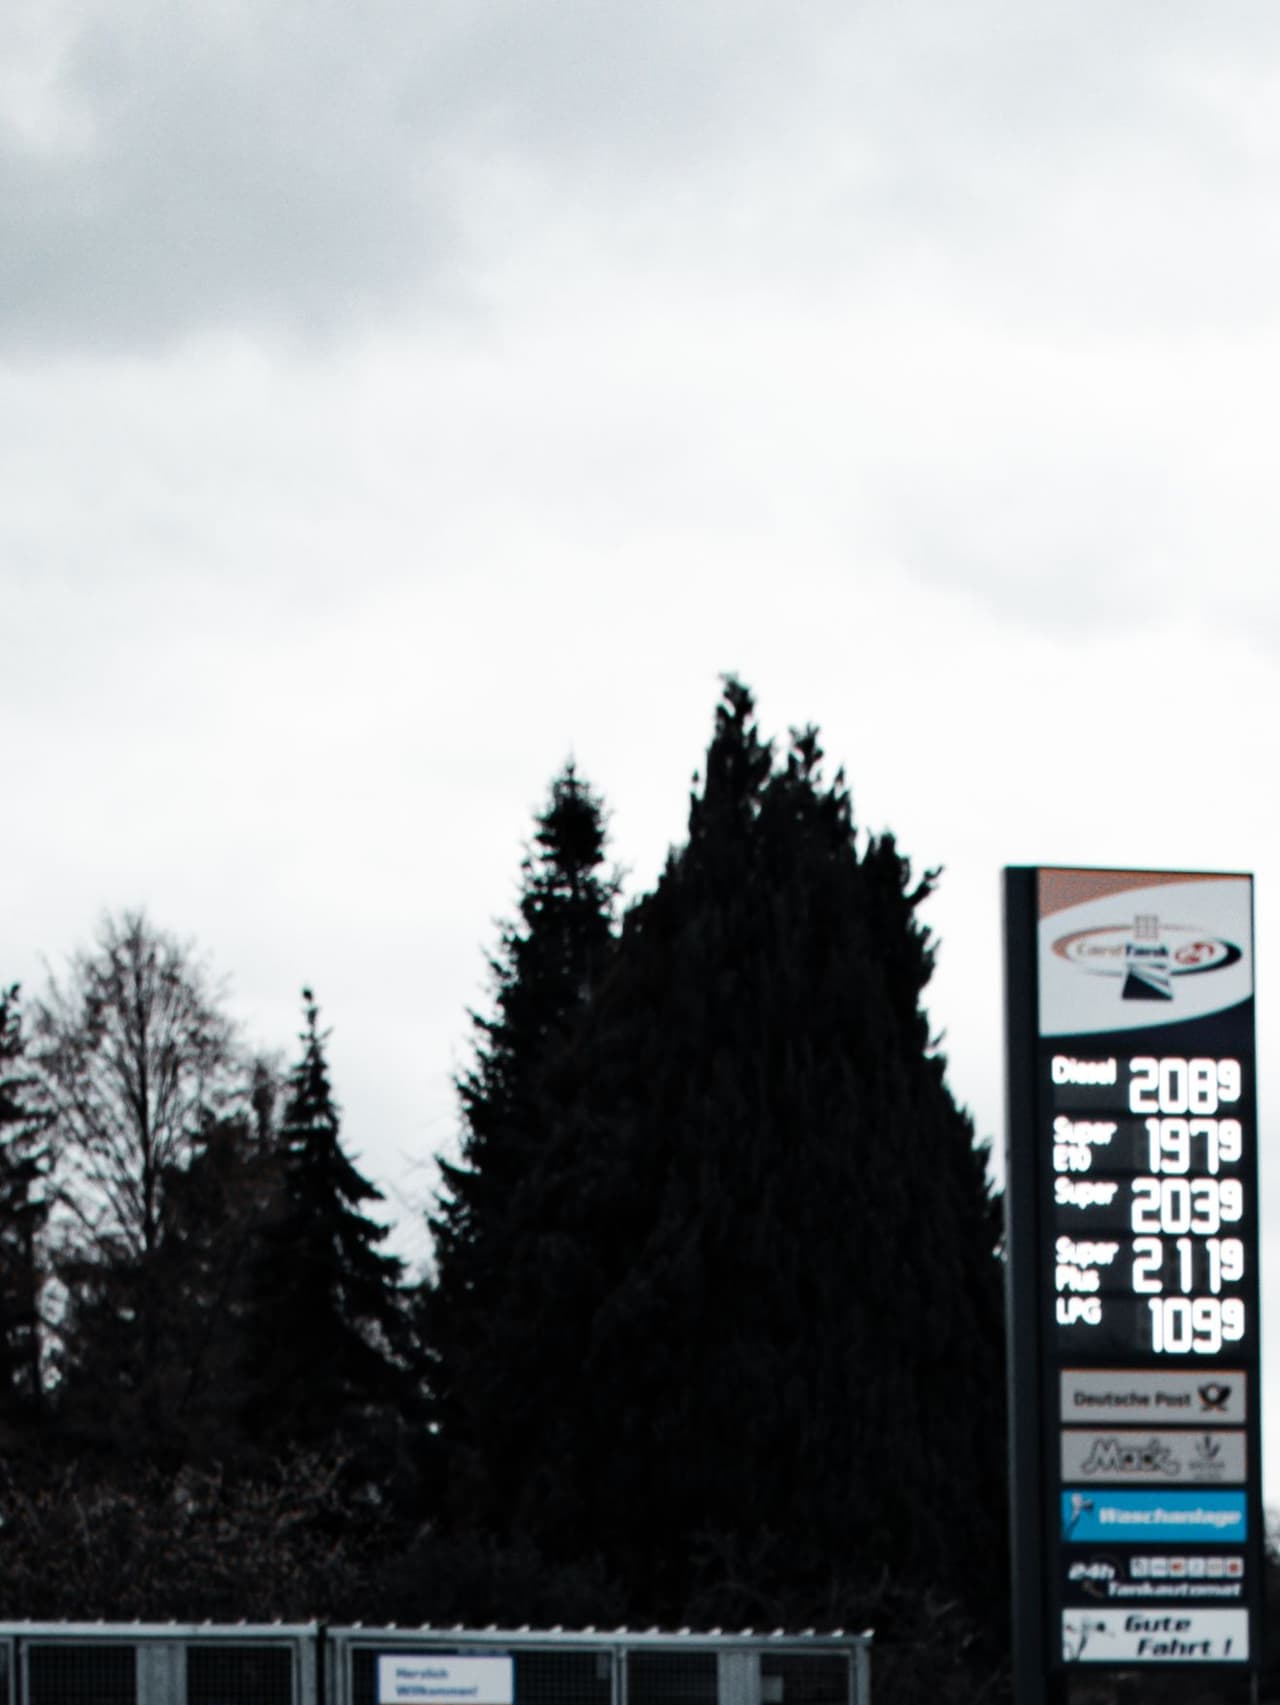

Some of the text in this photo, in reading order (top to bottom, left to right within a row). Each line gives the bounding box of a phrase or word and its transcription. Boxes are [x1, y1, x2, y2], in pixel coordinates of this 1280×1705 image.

[1056, 1297, 1102, 1325] LPG
[1074, 1391, 1192, 1407] Deutsche Post
[1099, 1508, 1241, 1528] Waschanlage
[1068, 1562, 1115, 1580] 24h
[1124, 1614, 1192, 1633] Gute
[1137, 1637, 1212, 1657] Fahrt
